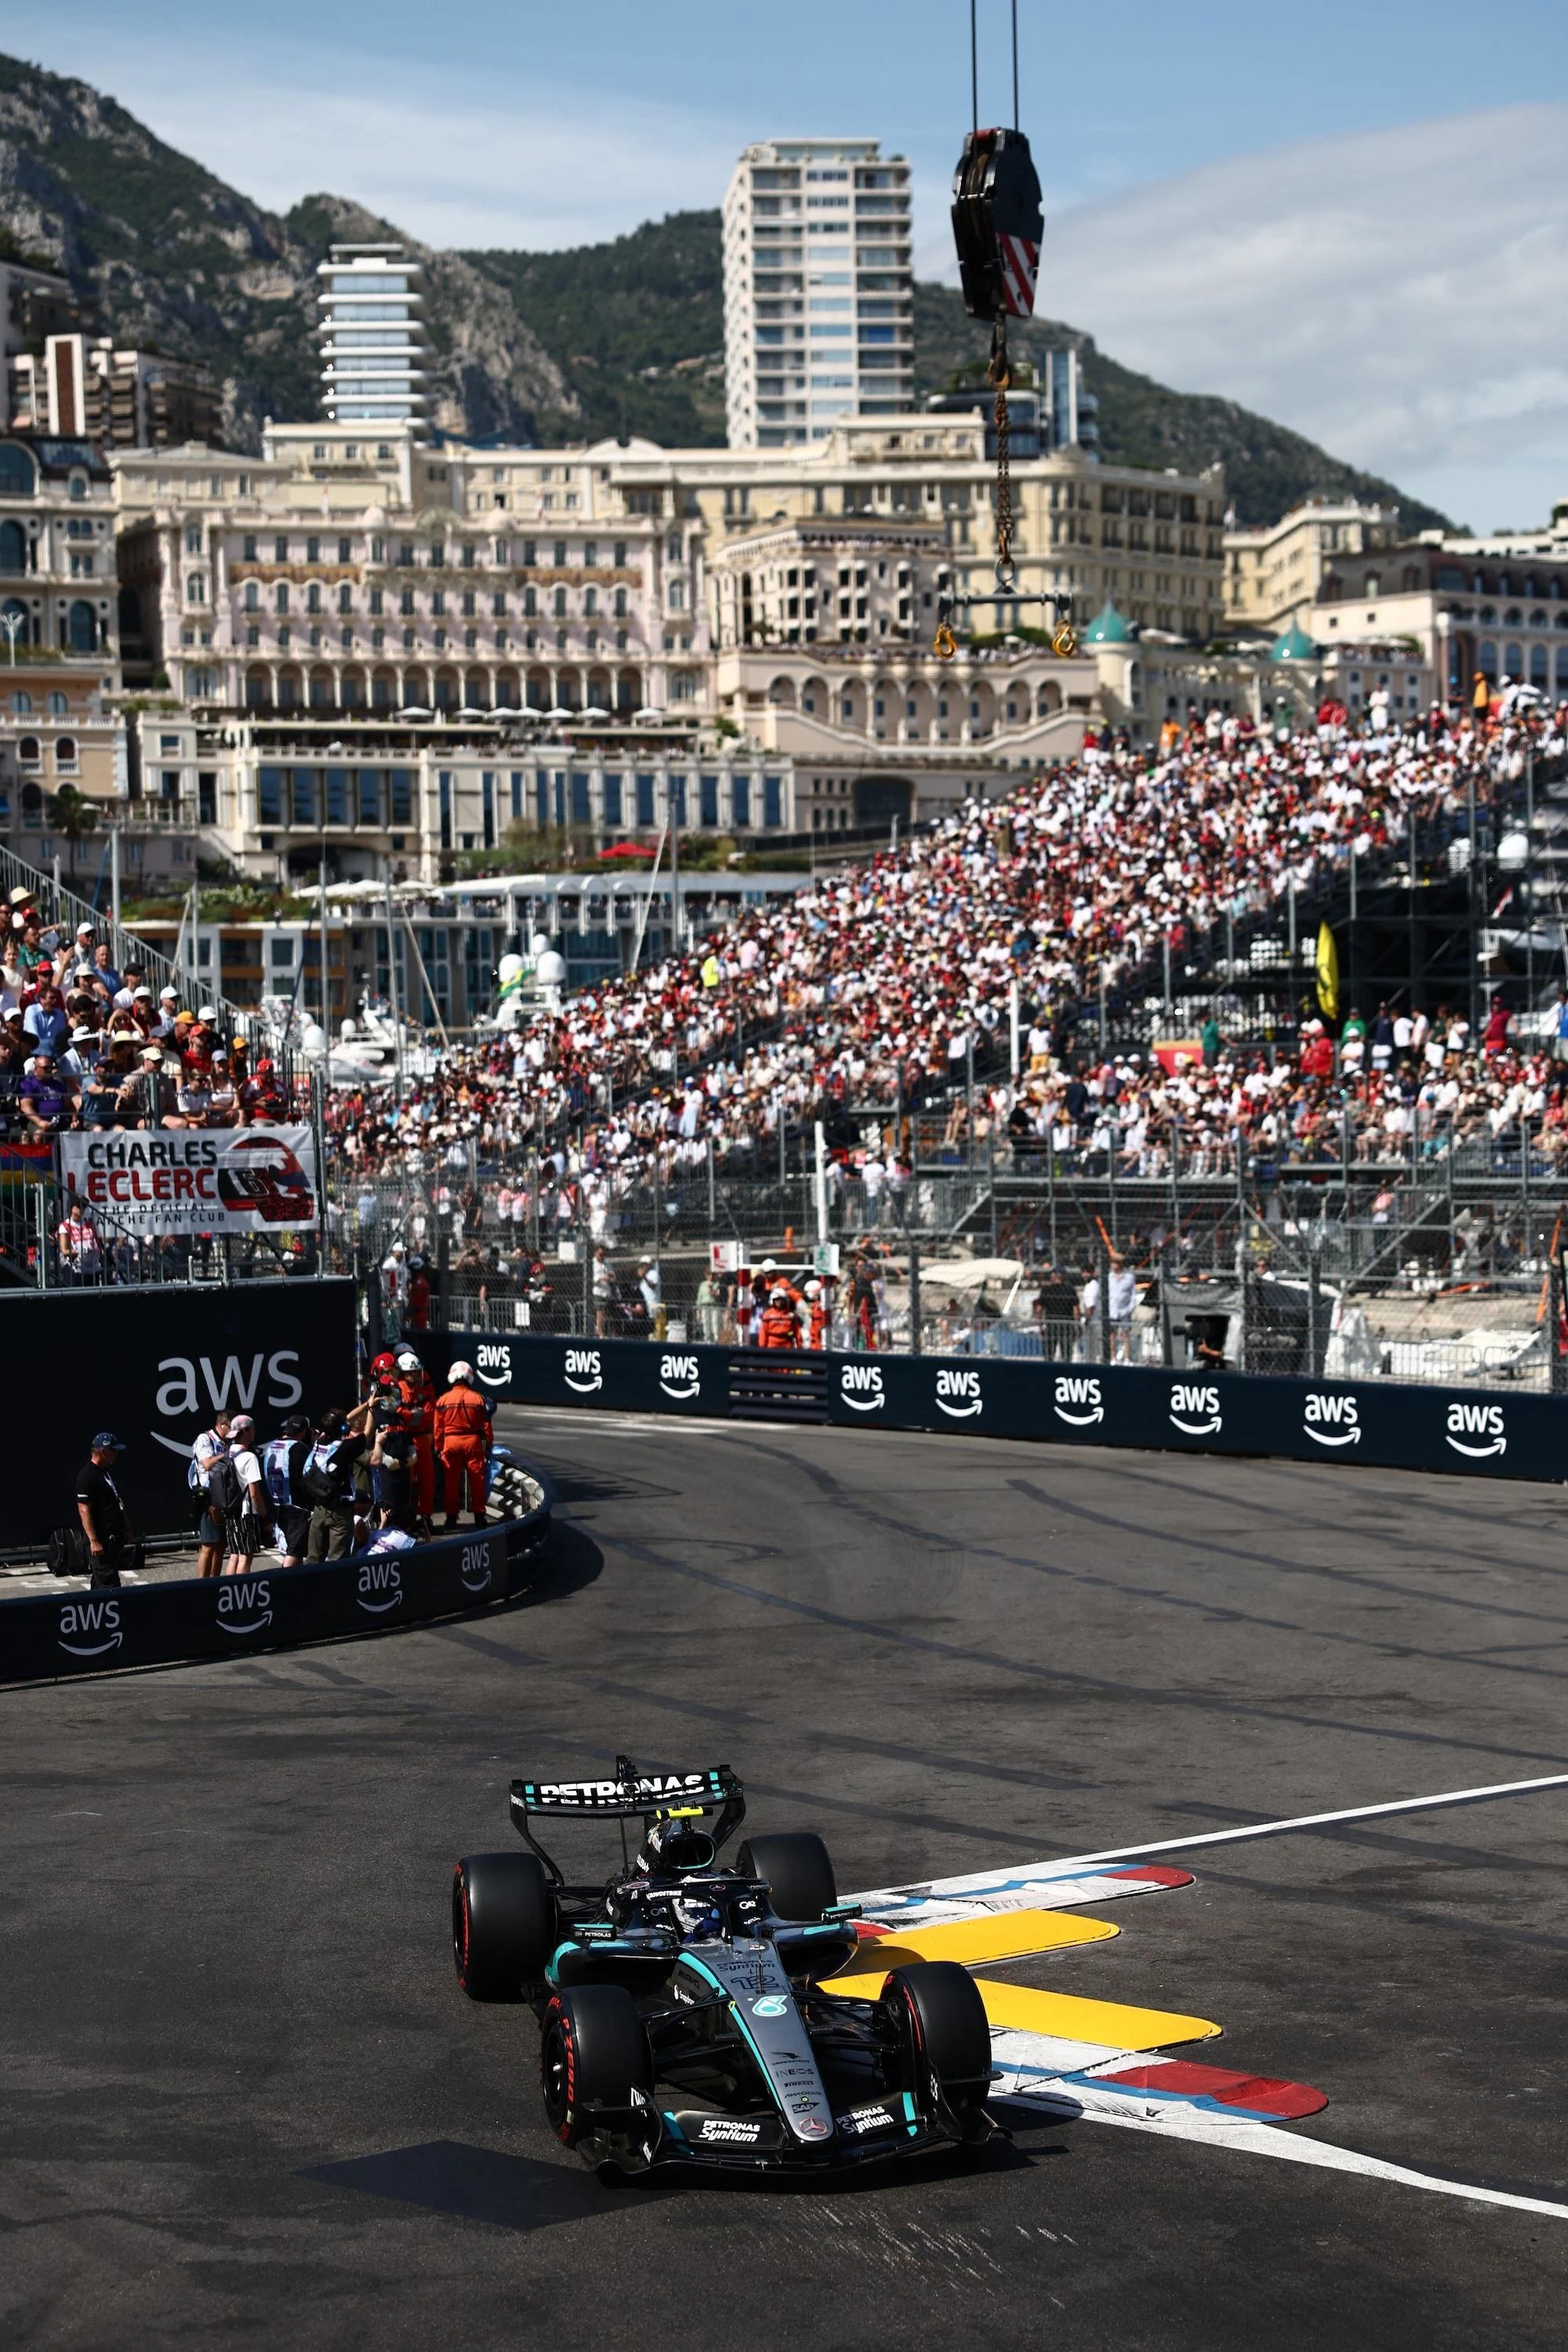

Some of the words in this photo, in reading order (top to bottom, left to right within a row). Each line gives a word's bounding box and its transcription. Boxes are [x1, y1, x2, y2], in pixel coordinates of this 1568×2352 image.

[88, 1141, 217, 1168] CHARLES
[103, 1205, 129, 1214] THE
[140, 1202, 207, 1214] OFFICIAL
[155, 1214, 182, 1224] FAN
[191, 1212, 225, 1222] CLUB
[477, 1344, 510, 1368] aws
[564, 1349, 601, 1374] aws
[660, 1355, 699, 1381] aws
[156, 1350, 303, 1416] aws
[841, 1365, 883, 1392] aws
[936, 1370, 981, 1398] aws
[1054, 1377, 1102, 1405] aws
[1171, 1385, 1220, 1414] aws
[1305, 1394, 1358, 1425] aws
[1447, 1403, 1504, 1435] aws
[462, 1542, 490, 1572] aws
[358, 1561, 401, 1592] aws
[217, 1580, 270, 1613] aws
[60, 1600, 120, 1634] aws
[540, 1774, 704, 1804] PETRONAS
[564, 2035, 574, 2103] ZERO
[776, 2068, 814, 2078] INEOS
[793, 2103, 815, 2113] SAP
[836, 2106, 885, 2125] PETRONAS
[698, 2126, 758, 2143] Syntium
[702, 2119, 760, 2132] PETRONAS
[842, 2114, 894, 2133] Syntium
